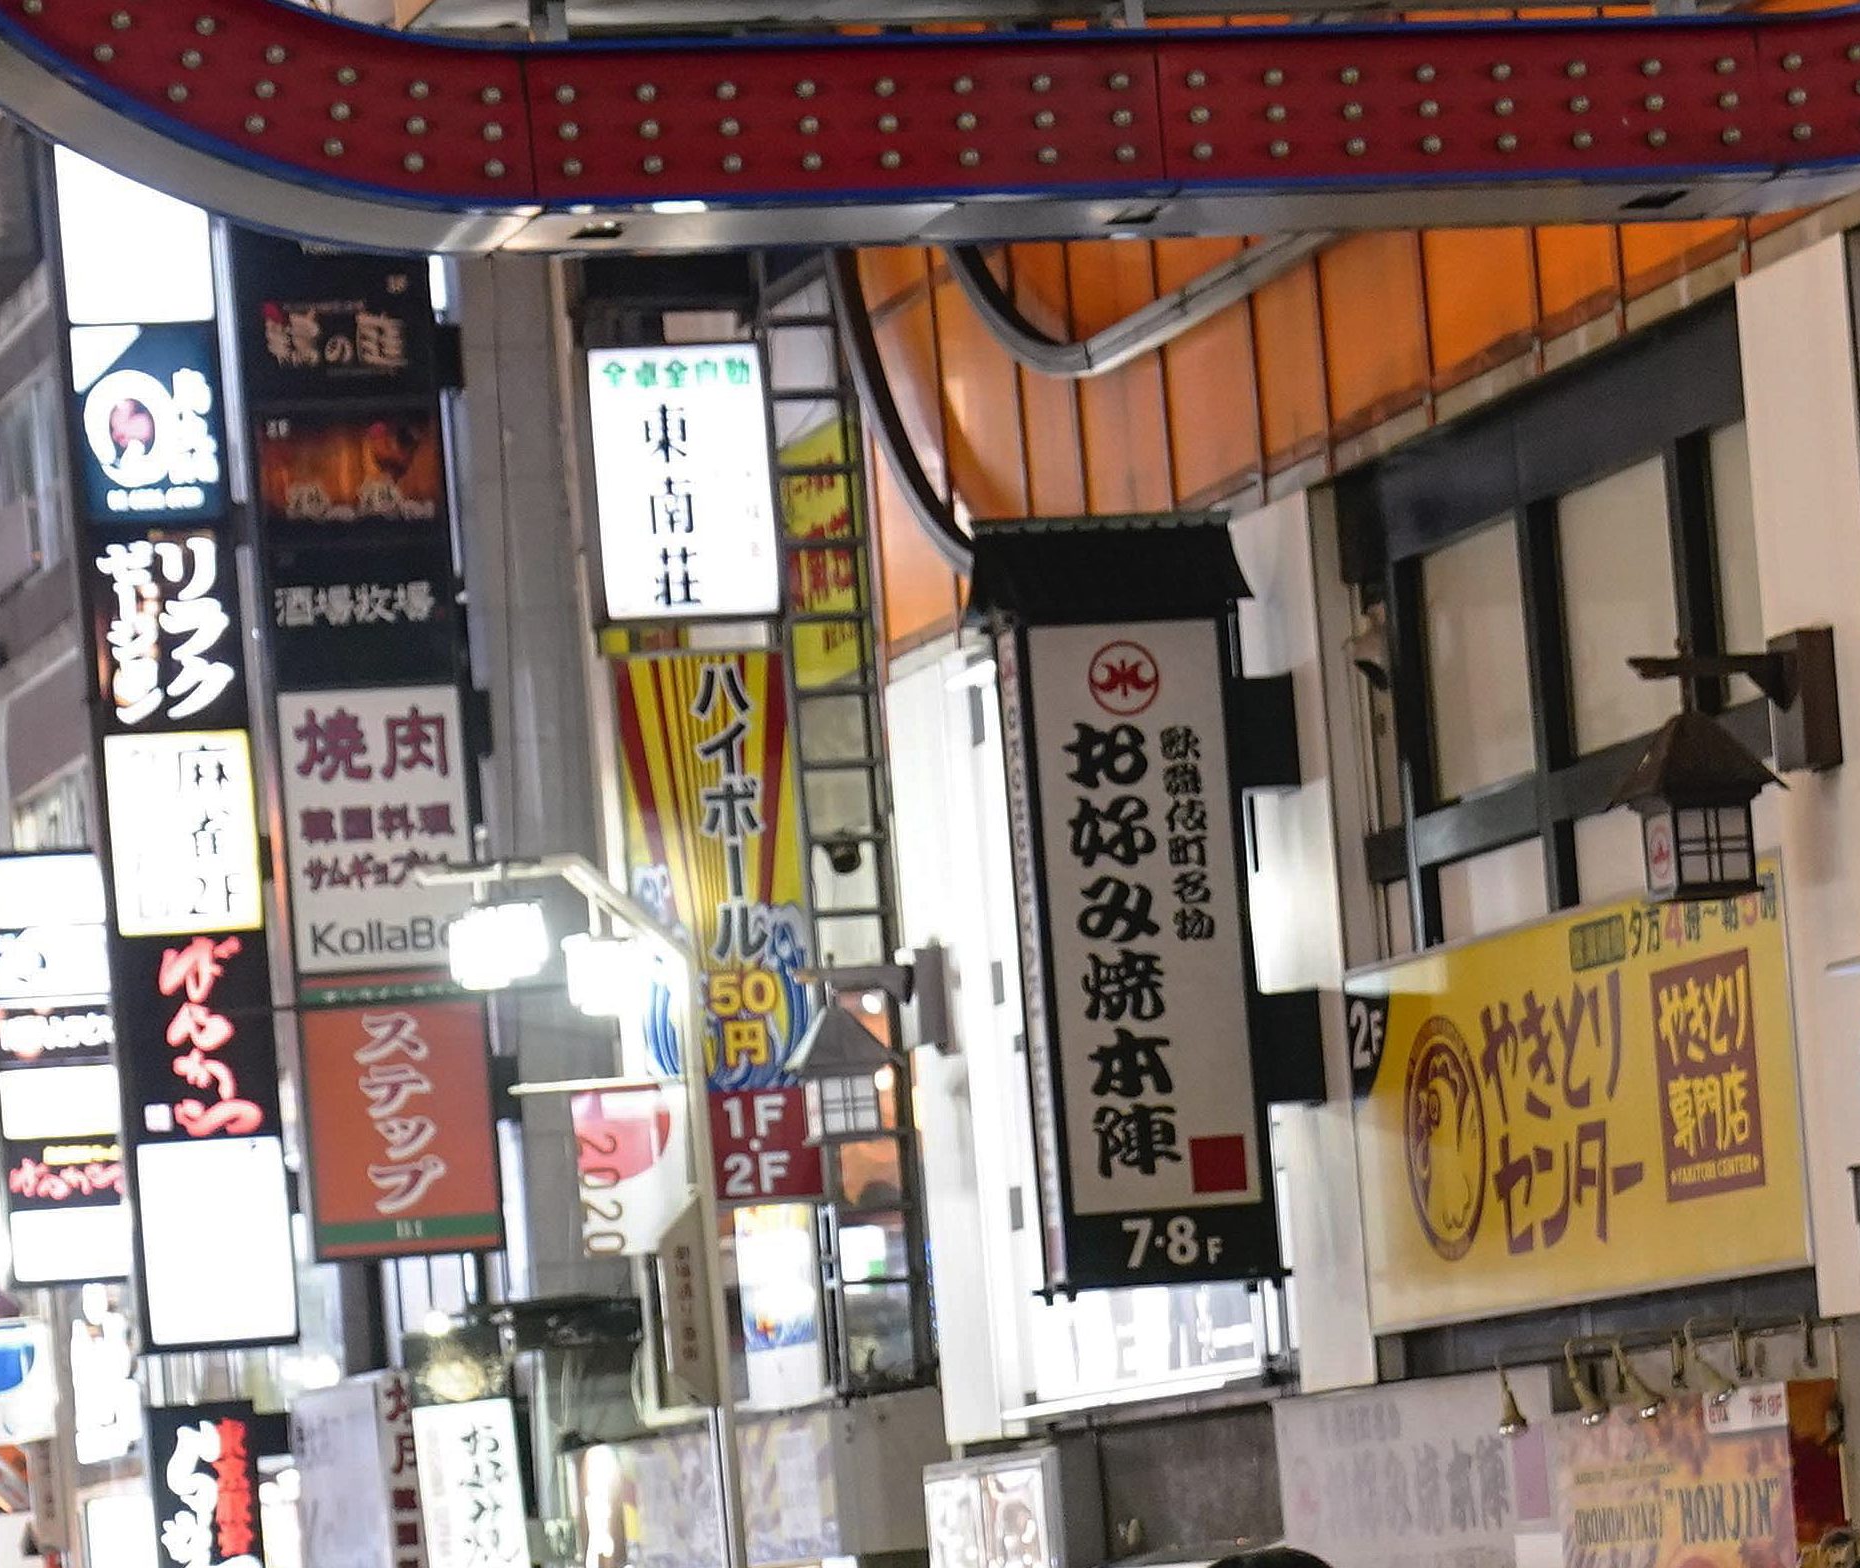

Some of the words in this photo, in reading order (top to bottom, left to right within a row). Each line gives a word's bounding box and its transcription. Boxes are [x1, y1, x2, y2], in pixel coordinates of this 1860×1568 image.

[644, 403, 701, 606] 東南荘
[692, 664, 768, 962] ハイボール
[1062, 721, 1183, 1180] お好み焼本陣
[1657, 963, 1748, 1067] やきとり
[353, 1010, 448, 1215] ステップ
[1480, 967, 1622, 1124] やきとり
[1666, 1060, 1750, 1158] 専門店
[723, 1150, 791, 1196] 2F
[1492, 1118, 1644, 1257] センター
